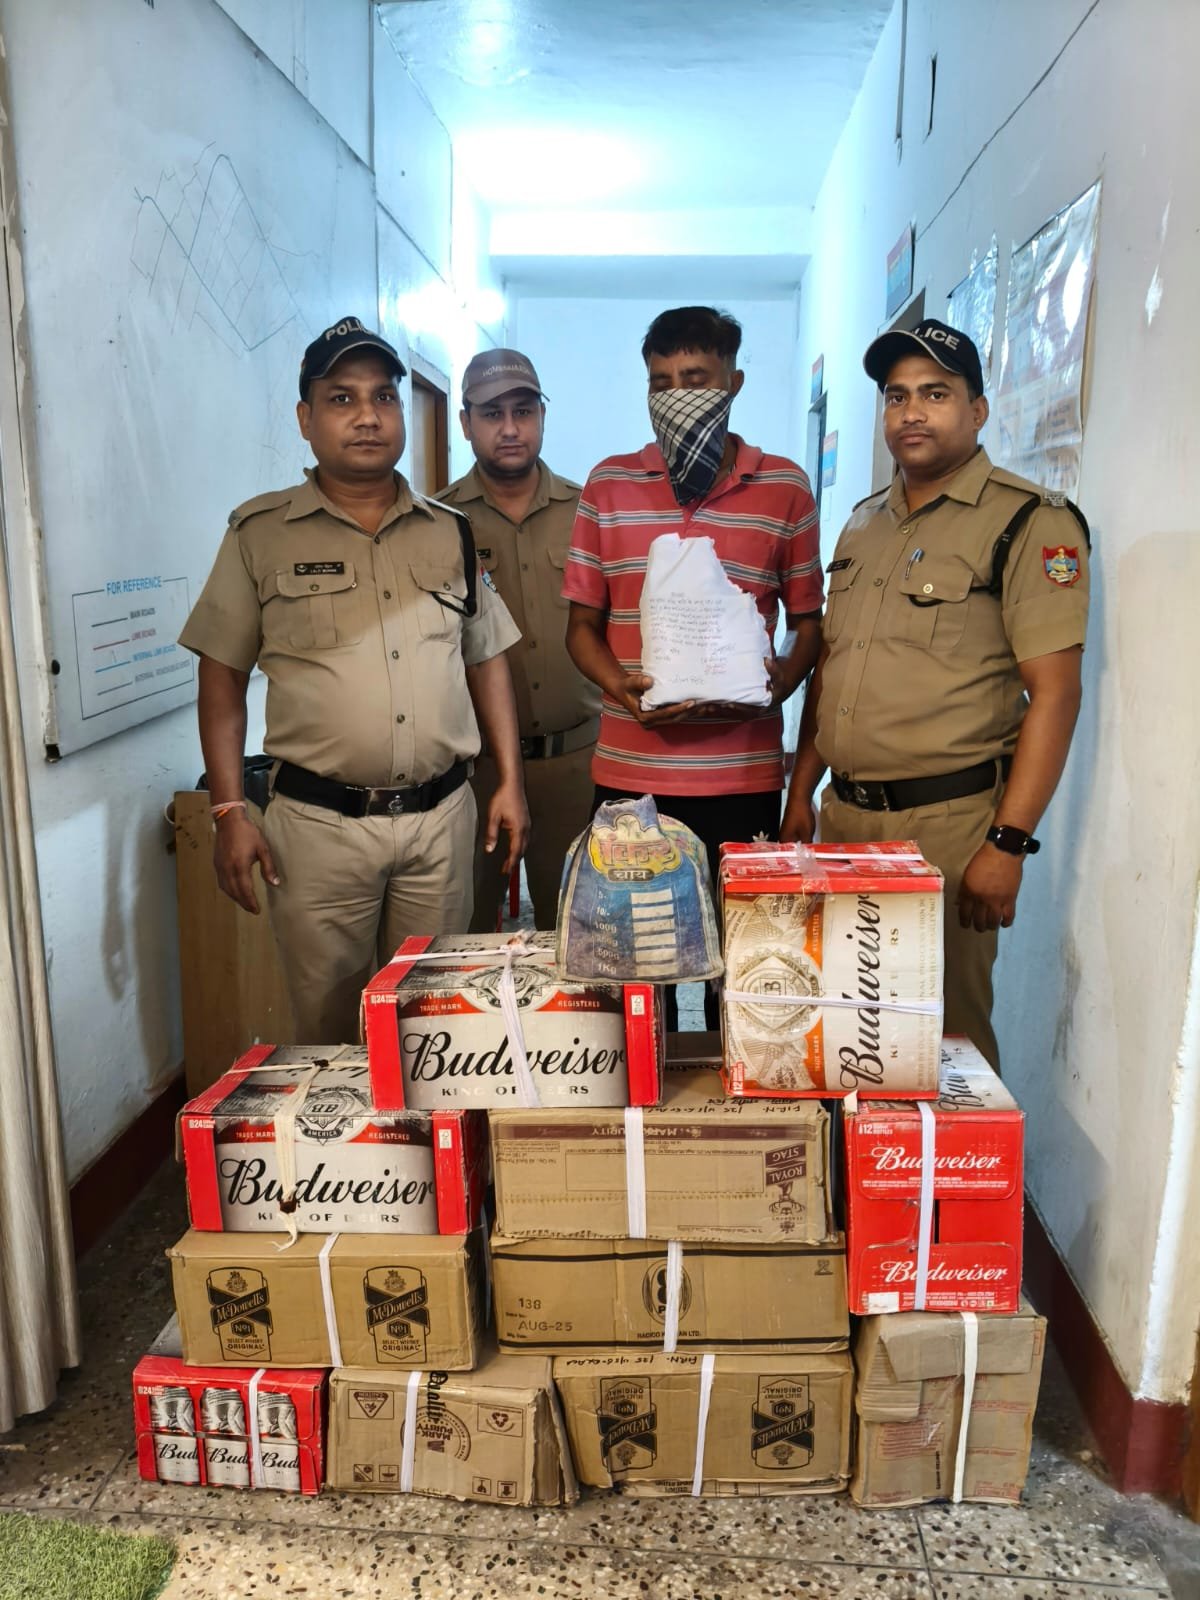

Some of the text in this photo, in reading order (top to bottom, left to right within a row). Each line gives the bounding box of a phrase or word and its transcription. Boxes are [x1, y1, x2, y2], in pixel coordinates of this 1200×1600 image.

[325, 320, 373, 341] POLI
[914, 327, 960, 350] LICE
[106, 576, 162, 595] FOR REFERENCE
[614, 870, 648, 880] चाय
[839, 894, 884, 1088] Budweiser
[558, 1000, 600, 1008] REGISTERED
[403, 1031, 625, 1082] Budweiser
[307, 1130, 338, 1138] AMERICA
[368, 1132, 410, 1140] REGISTERED
[591, 1126, 627, 1136] URITY
[772, 1146, 799, 1162] STAG
[770, 1165, 803, 1182] ROYAL
[220, 1158, 435, 1206] Budweiser
[309, 1213, 333, 1222] OF
[216, 1293, 265, 1323] McDowell's
[372, 1291, 423, 1323] McDowell's
[518, 1297, 541, 1310] 138
[518, 1321, 573, 1332] AUG-25
[416, 1423, 454, 1435] PURITY
[421, 1430, 451, 1441] MARK
[757, 1413, 809, 1445] McDowell's
